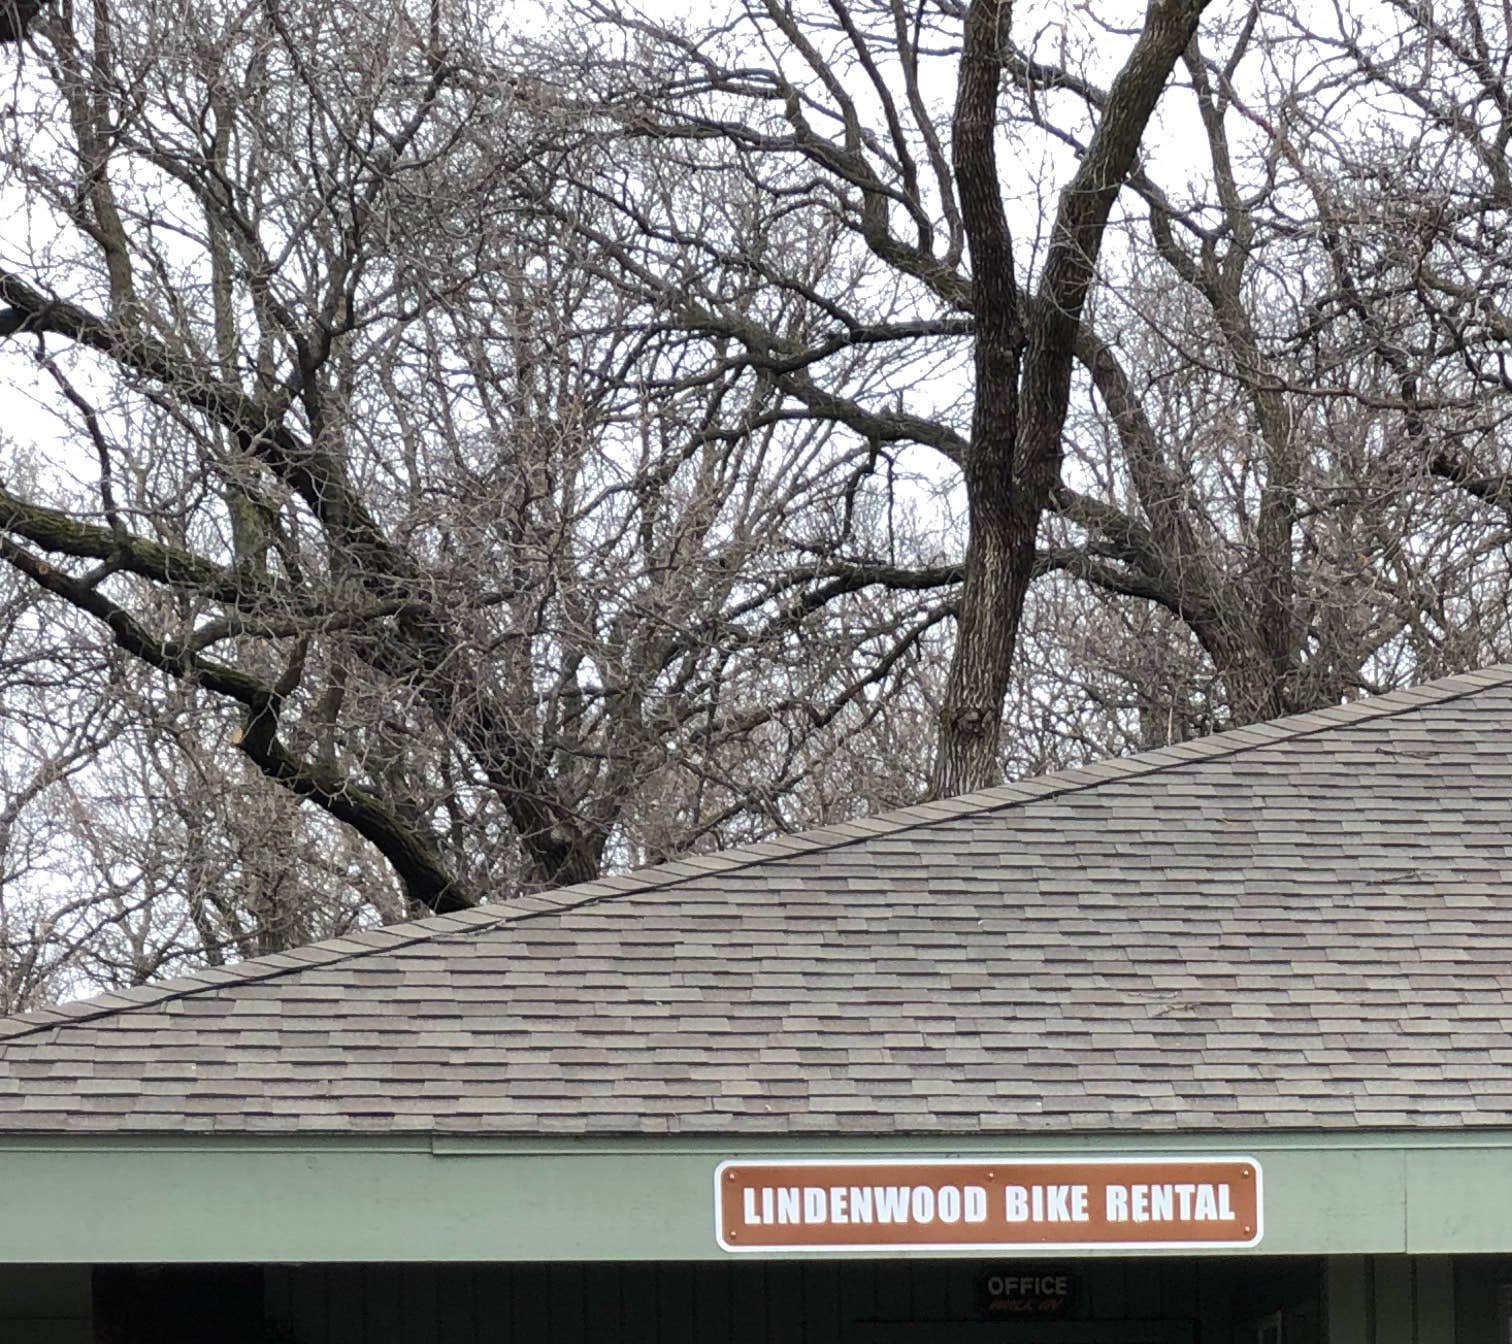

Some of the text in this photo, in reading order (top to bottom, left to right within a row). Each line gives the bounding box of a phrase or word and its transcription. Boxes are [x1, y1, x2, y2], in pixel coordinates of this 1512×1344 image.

[743, 1184, 1235, 1225] LINDENWOOD BIKE RENTAL
[988, 1276, 1067, 1295] OFFICE
